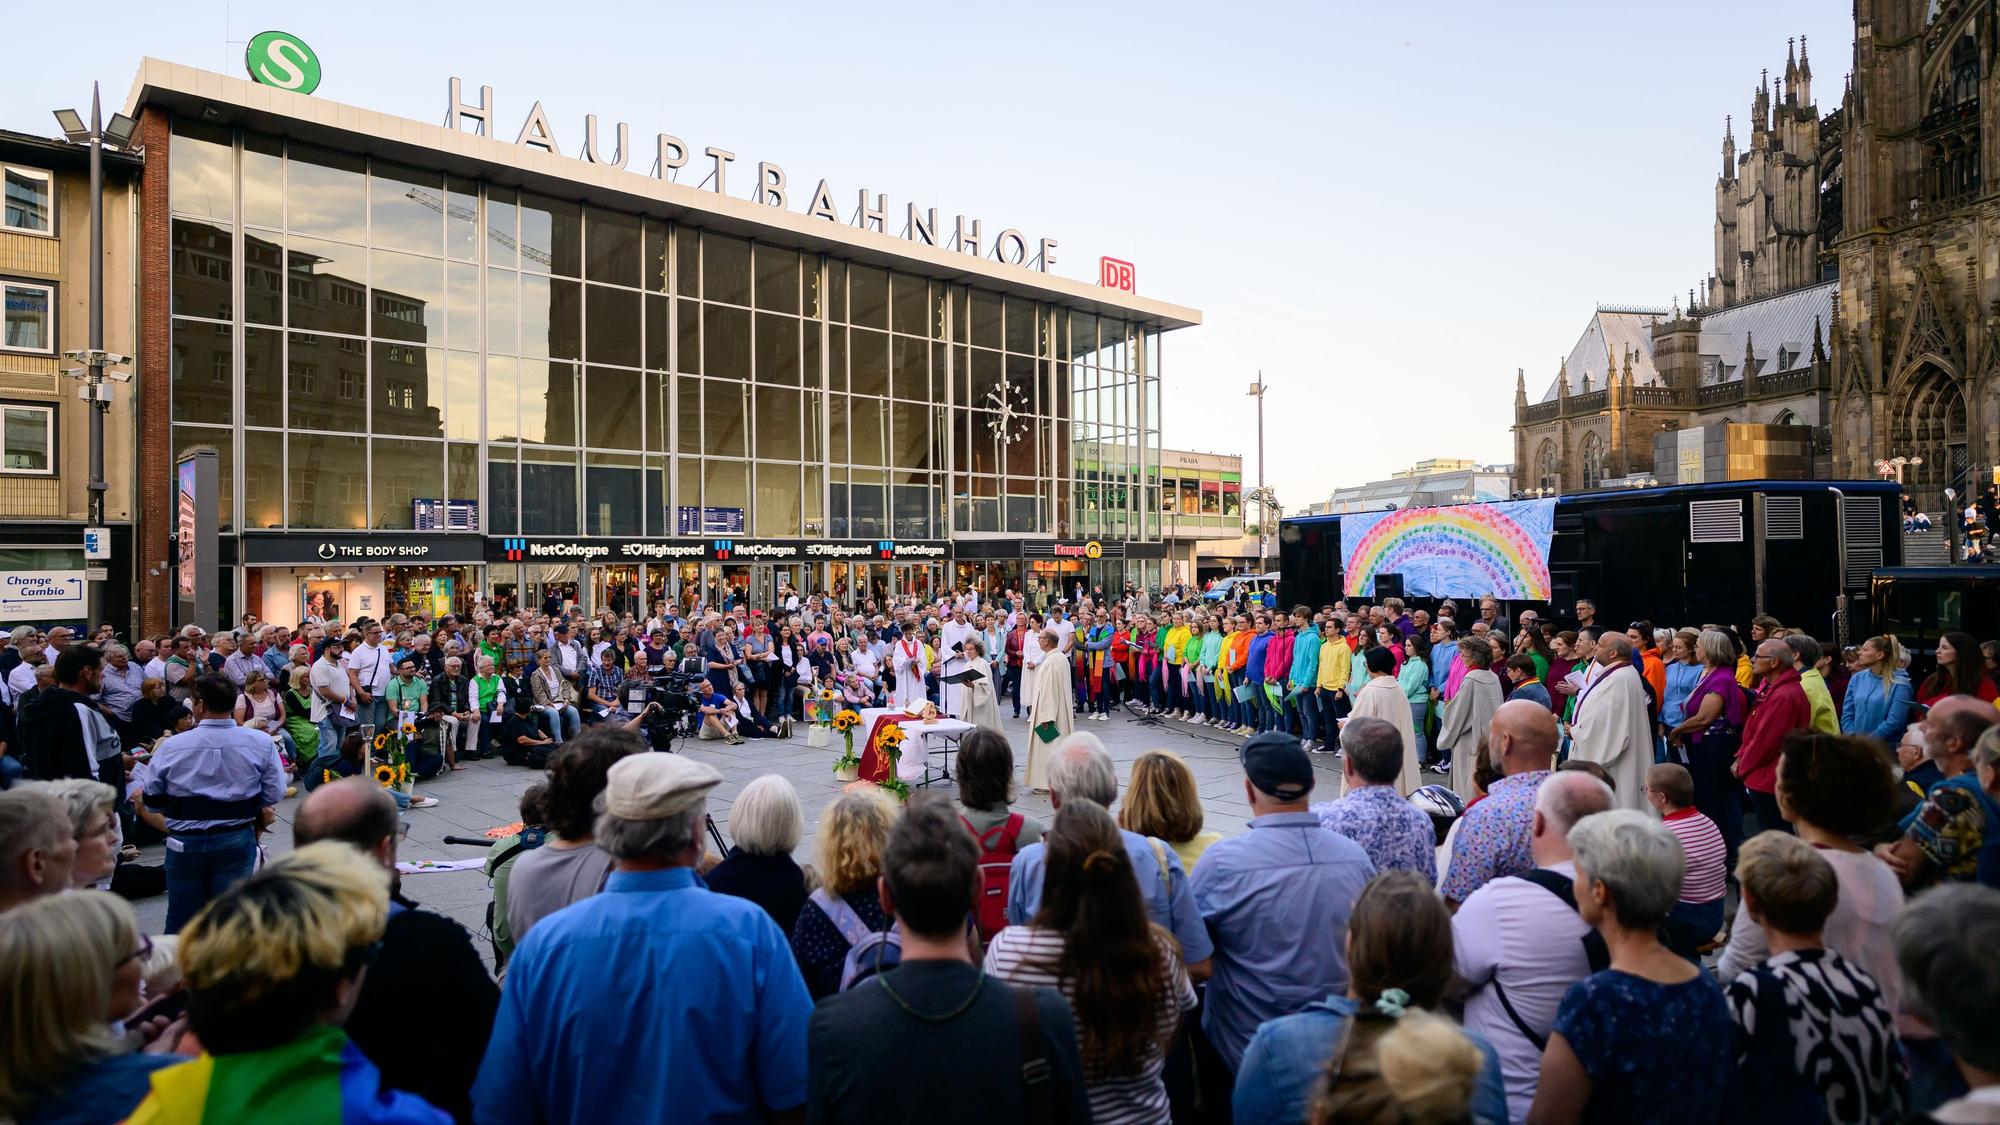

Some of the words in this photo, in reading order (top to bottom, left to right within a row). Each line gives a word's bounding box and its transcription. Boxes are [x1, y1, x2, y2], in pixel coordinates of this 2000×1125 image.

[260, 39, 309, 89] S
[449, 76, 1058, 273] HAUPTBAHNHOF
[1104, 262, 1133, 292] DB
[1180, 456, 1199, 465] PRADA
[340, 546, 363, 556] THE
[366, 546, 396, 556] BODY
[398, 546, 429, 556] SHOP
[530, 543, 609, 558] NetCologne
[642, 544, 705, 558] Highspeed
[734, 544, 797, 557] NetCologne
[823, 544, 872, 557] Highspeed
[894, 544, 945, 557] NetCologne
[1054, 543, 1087, 558] Kamps
[7, 576, 52, 587] Change
[20, 587, 65, 597] Cambio
